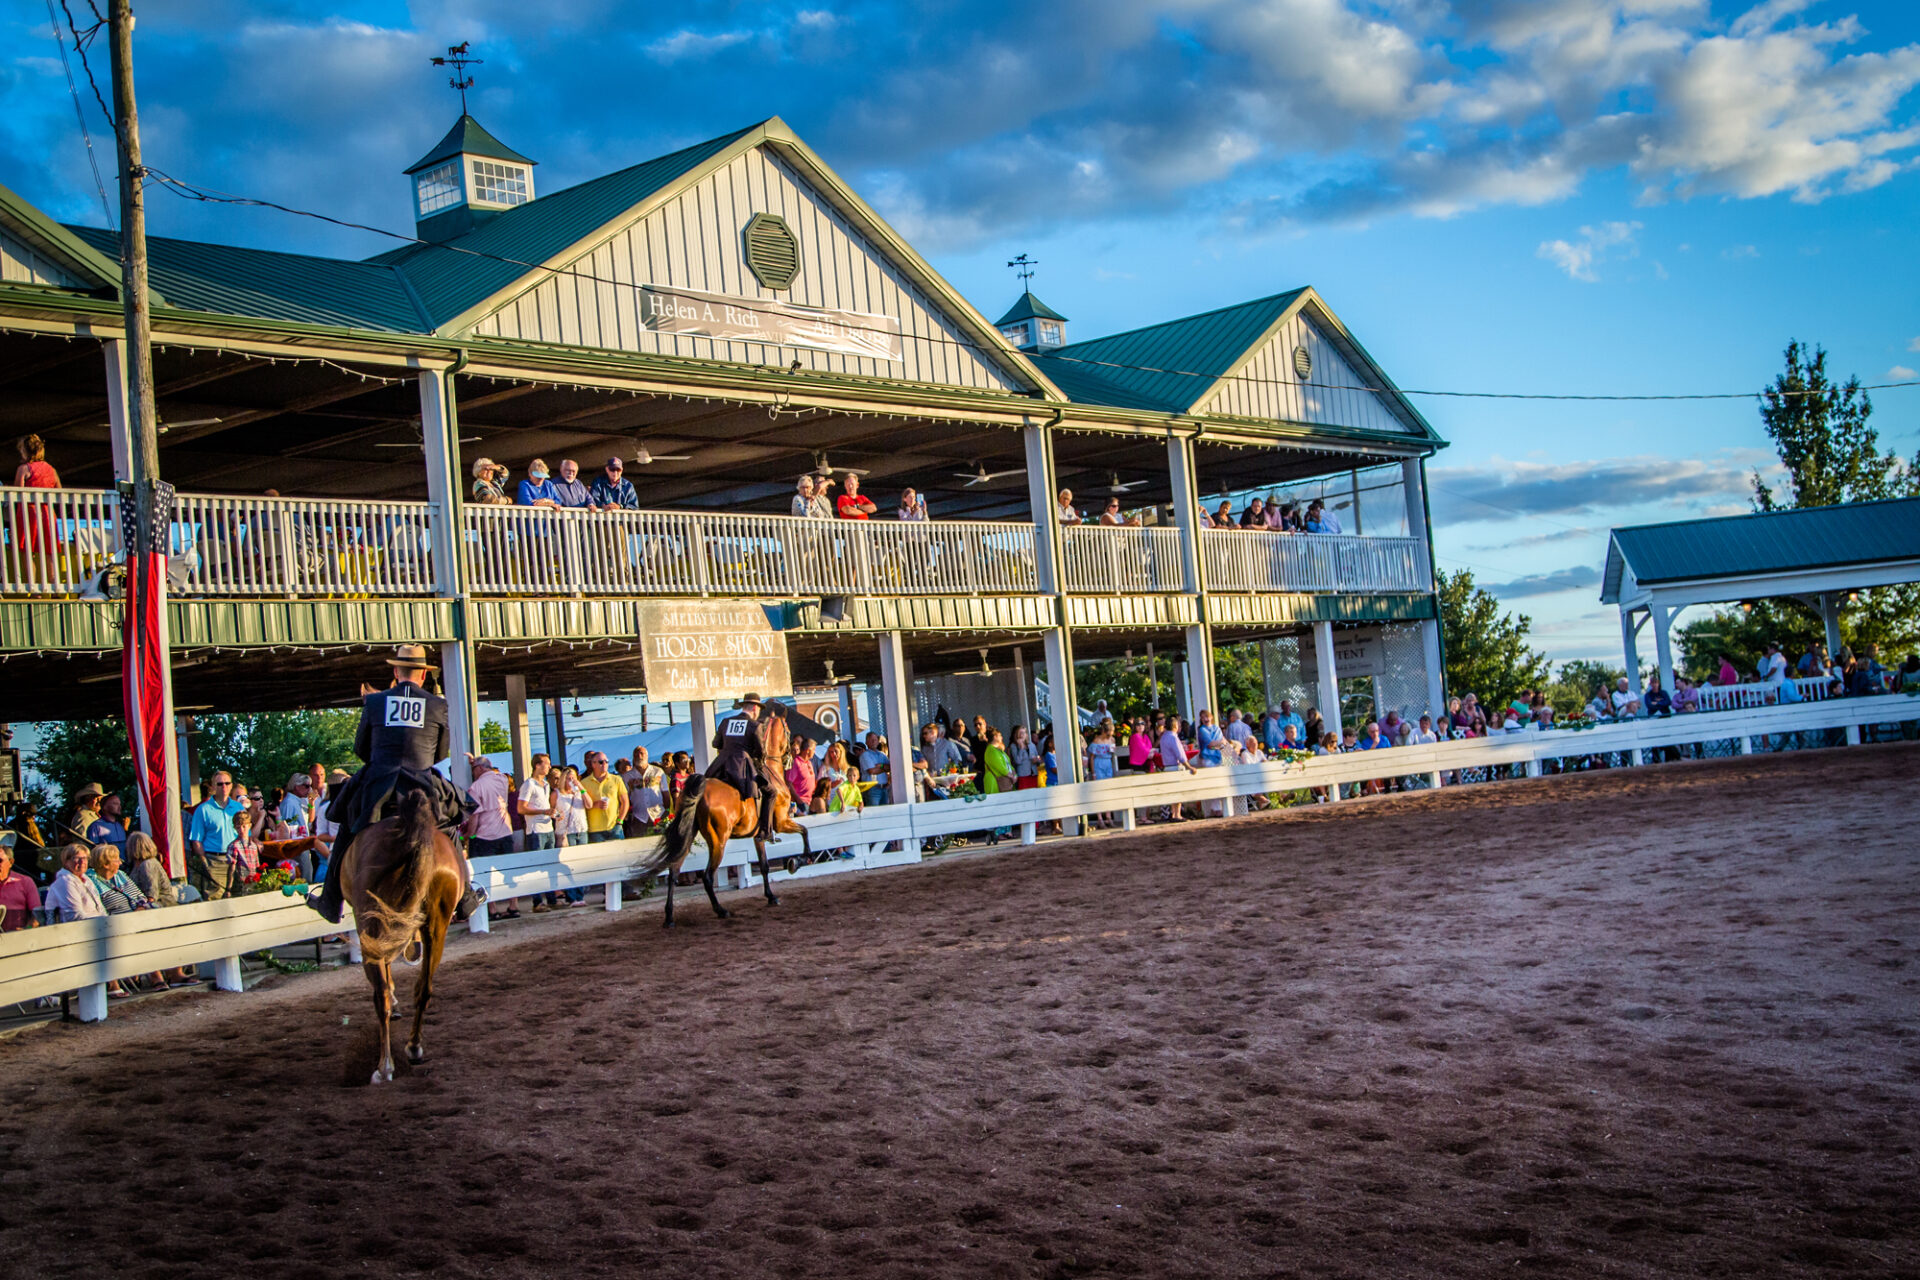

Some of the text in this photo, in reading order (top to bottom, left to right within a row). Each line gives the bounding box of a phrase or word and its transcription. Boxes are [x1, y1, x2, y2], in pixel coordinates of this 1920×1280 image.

[649, 295, 760, 328] Helen A. Rich
[655, 634, 774, 658] HORSE SHOW
[1336, 648, 1366, 660] TENT
[665, 665, 772, 689] "Catch The Excitement"
[389, 700, 422, 722] 208
[729, 720, 745, 735] 165
